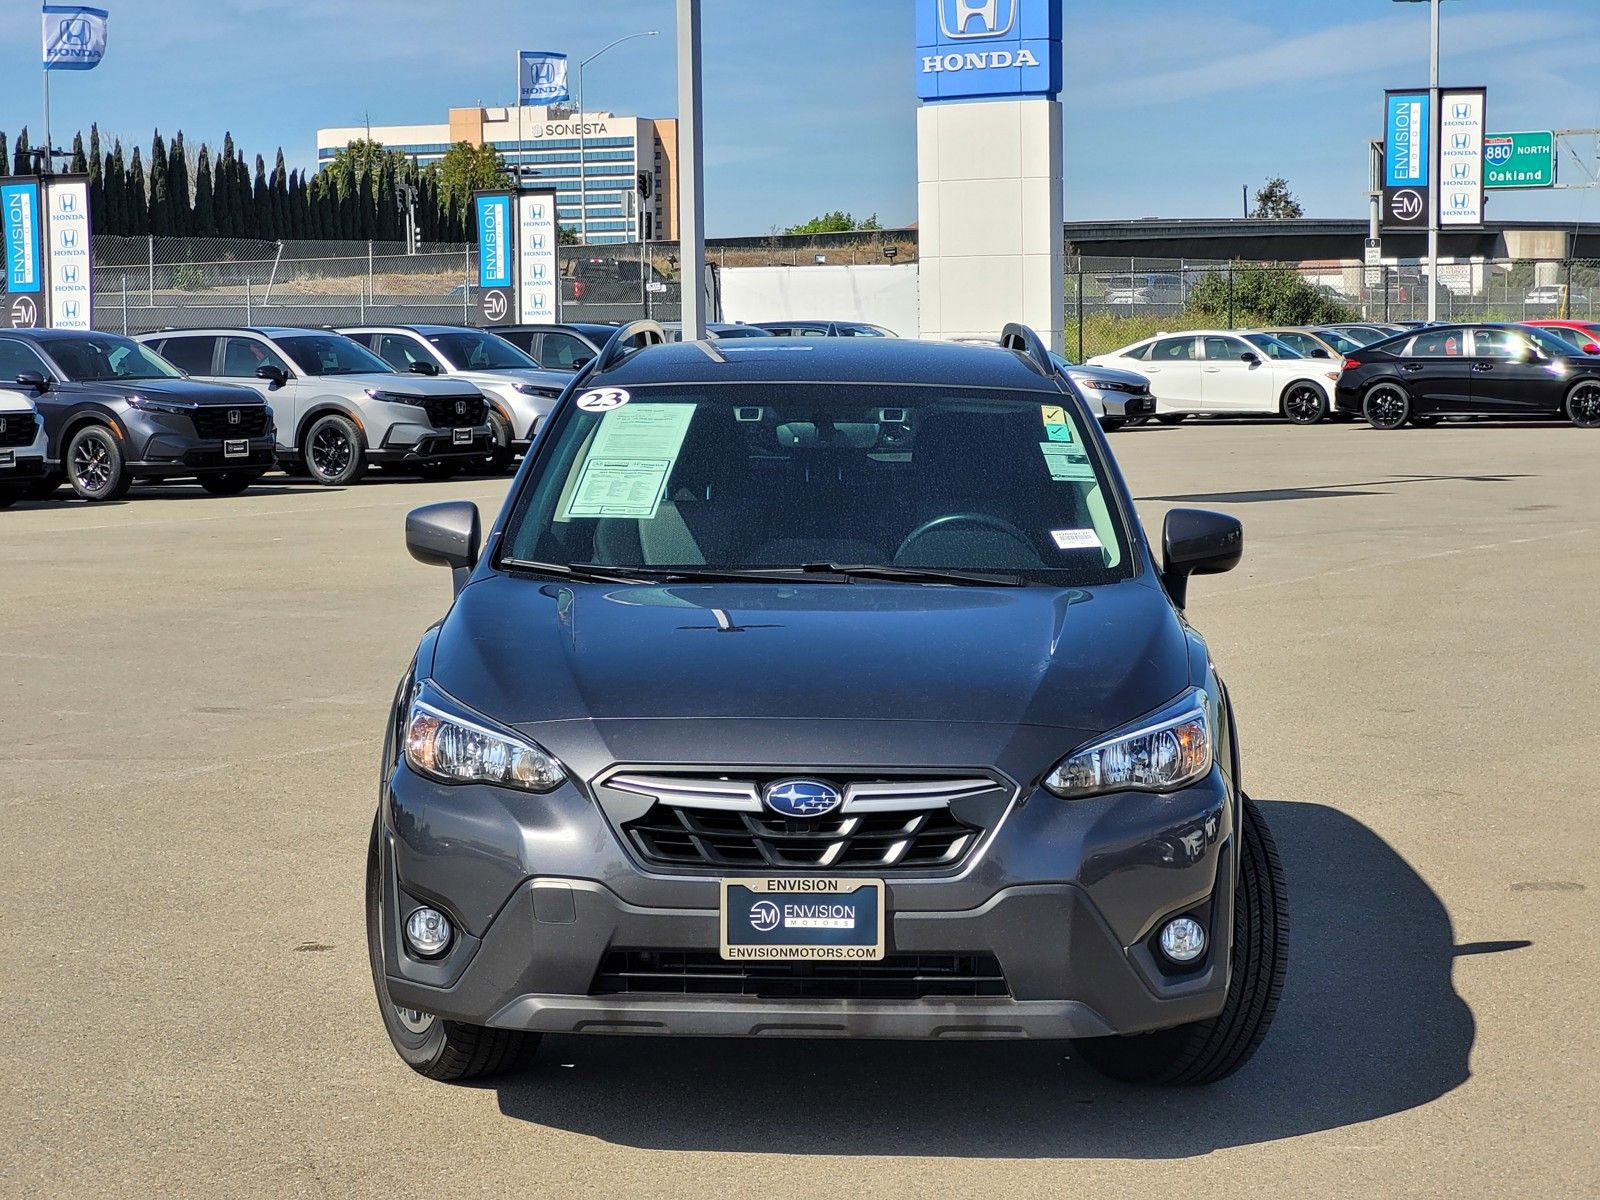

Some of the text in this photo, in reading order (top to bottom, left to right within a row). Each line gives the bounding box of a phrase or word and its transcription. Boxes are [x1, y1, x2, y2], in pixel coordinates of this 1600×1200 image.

[47, 48, 101, 58] HONDA
[922, 49, 1039, 73] HONDA
[521, 85, 568, 95] HONDA
[545, 123, 608, 135] SONESTA
[1394, 102, 1410, 179] ENVISION
[1486, 145, 1550, 159] 880 NORTH
[1489, 169, 1542, 181] Oakland
[9, 193, 25, 284] ENVISION
[484, 203, 497, 280] ENVISION
[583, 392, 622, 407] 23
[767, 879, 838, 891] ENVISION
[784, 904, 855, 918] ENVISION
[728, 948, 876, 958] ENVISIONMOTORS.COM
